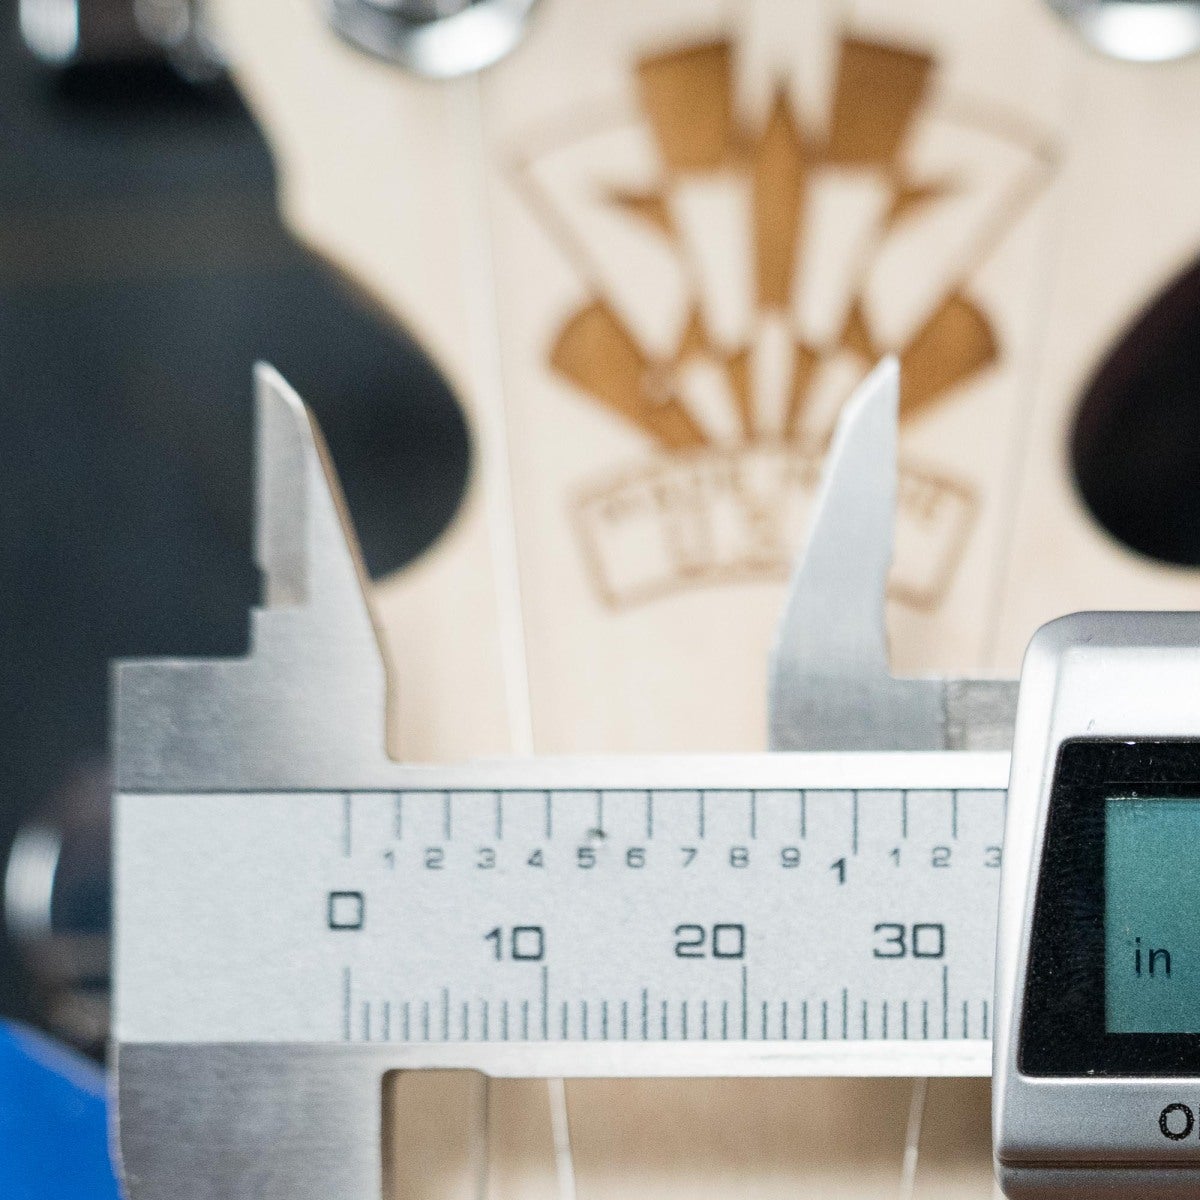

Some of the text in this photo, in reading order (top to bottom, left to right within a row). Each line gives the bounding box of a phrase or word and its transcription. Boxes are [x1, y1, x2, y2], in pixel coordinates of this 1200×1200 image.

[424, 846, 444, 870] 2
[476, 847, 497, 870] 3
[526, 848, 544, 869] 4
[576, 846, 596, 869] 5
[626, 846, 646, 869] 6
[680, 847, 698, 868] 7
[729, 846, 750, 869] 8
[780, 846, 801, 869] 9
[830, 857, 847, 886] 1
[888, 848, 902, 868] 1
[931, 846, 951, 868] 2
[483, 922, 946, 961] 10 20 30
[1133, 937, 1173, 980] in
